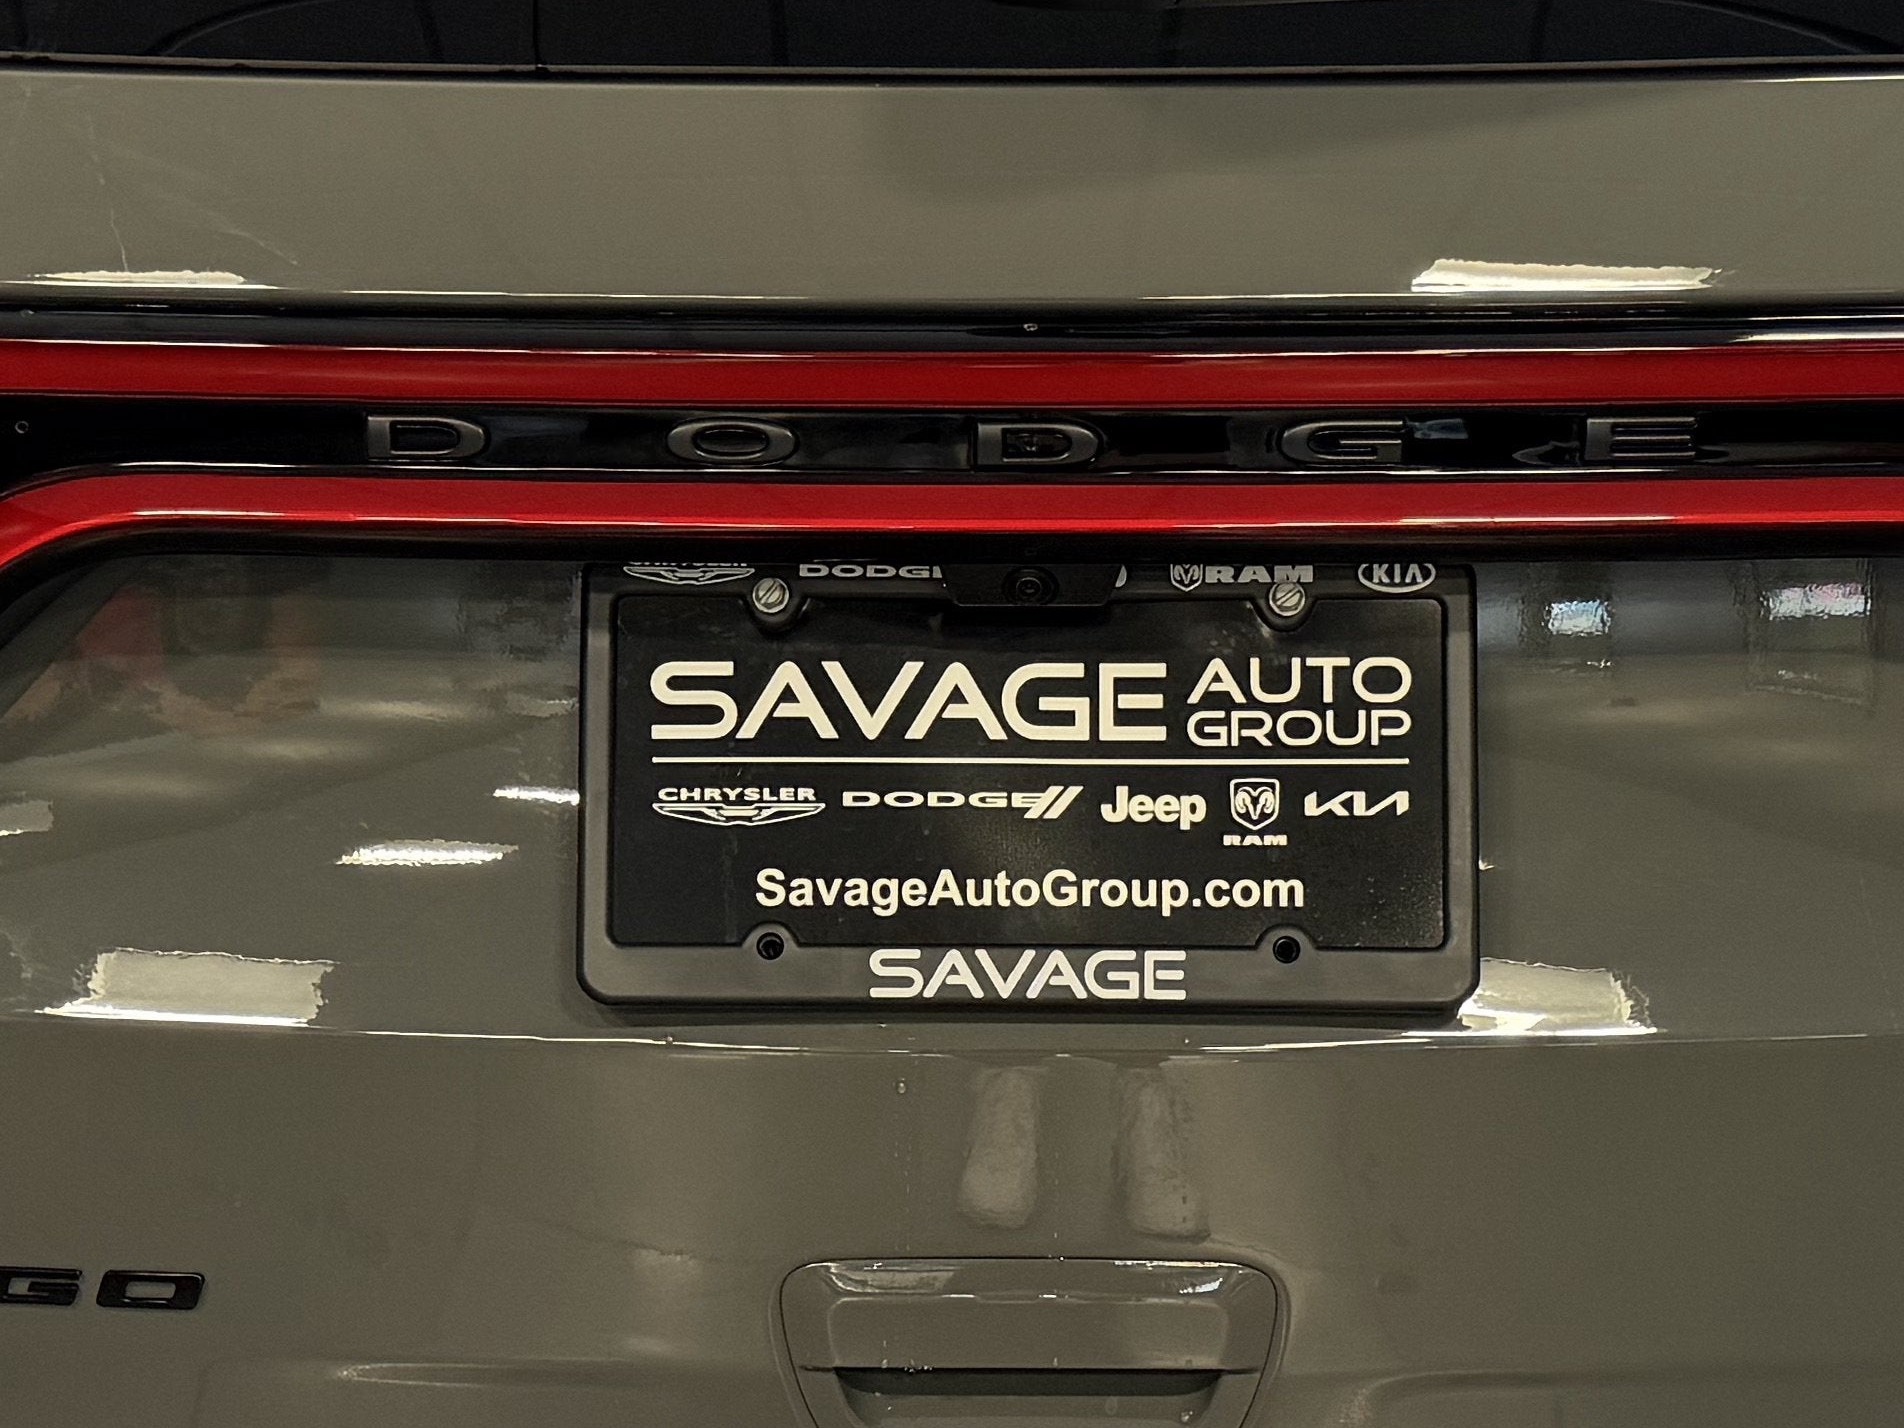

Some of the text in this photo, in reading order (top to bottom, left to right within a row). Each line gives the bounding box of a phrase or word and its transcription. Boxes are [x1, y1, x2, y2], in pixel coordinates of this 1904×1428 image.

[364, 414, 1698, 465] DODGE
[799, 564, 943, 578] DODG
[1205, 564, 1314, 584] RAM
[649, 660, 1168, 742] SAVAGE
[1186, 656, 1413, 705] AUTO
[1186, 709, 1413, 747] GROUP
[657, 787, 817, 802] CHRYSLER
[842, 791, 1042, 808] DODGE
[1100, 785, 1207, 831] Jeep
[1222, 834, 1288, 847] RAM
[755, 867, 1305, 917] SavageAutoGroup.com
[869, 948, 1188, 1001] SAVAGE
